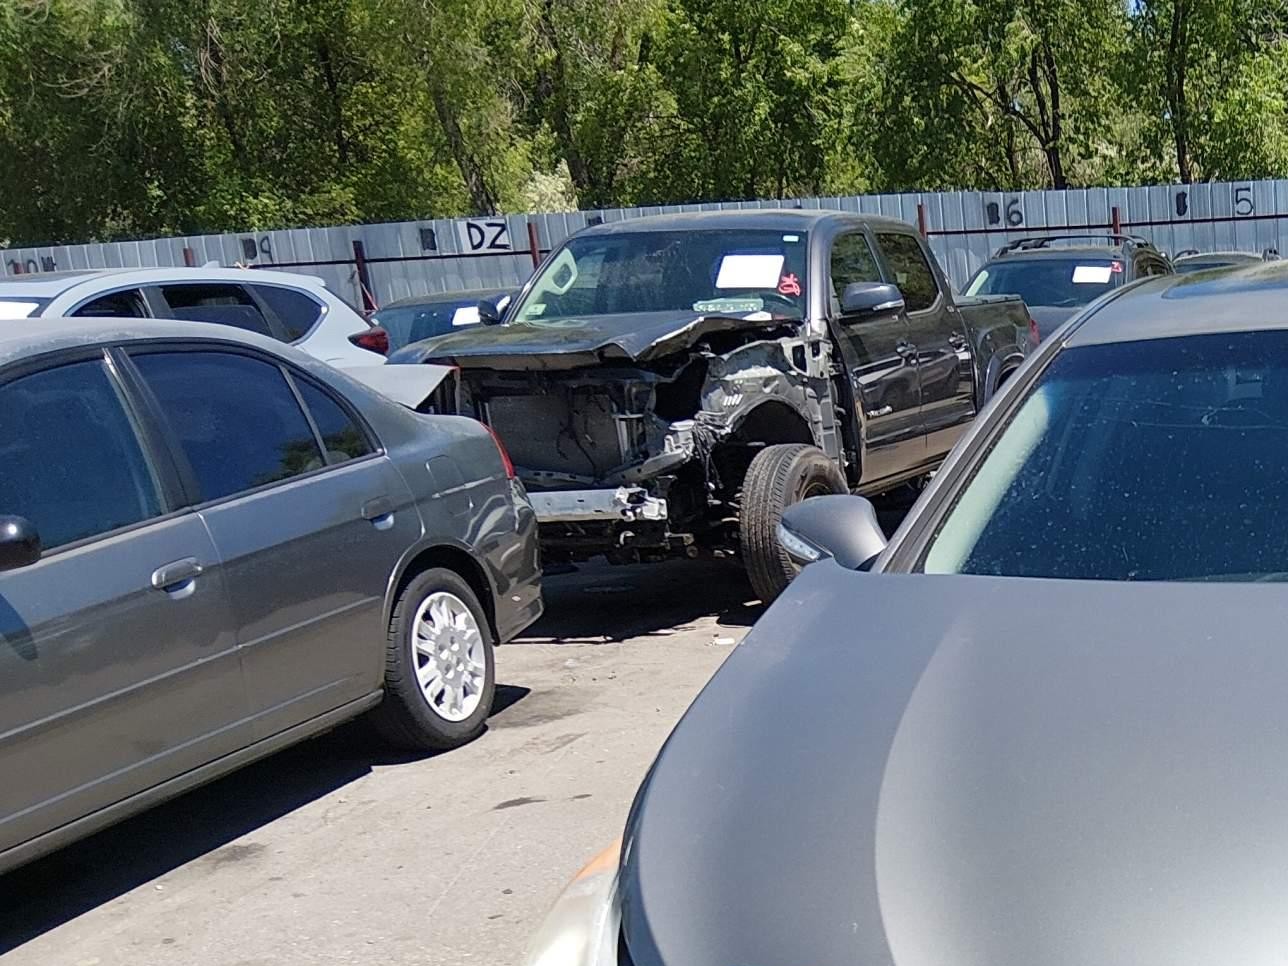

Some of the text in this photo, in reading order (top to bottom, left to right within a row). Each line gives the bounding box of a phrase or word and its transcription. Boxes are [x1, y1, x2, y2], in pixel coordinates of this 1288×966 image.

[1006, 198, 1024, 226] 6
[1234, 187, 1254, 216] 5
[466, 221, 512, 251] DZ
